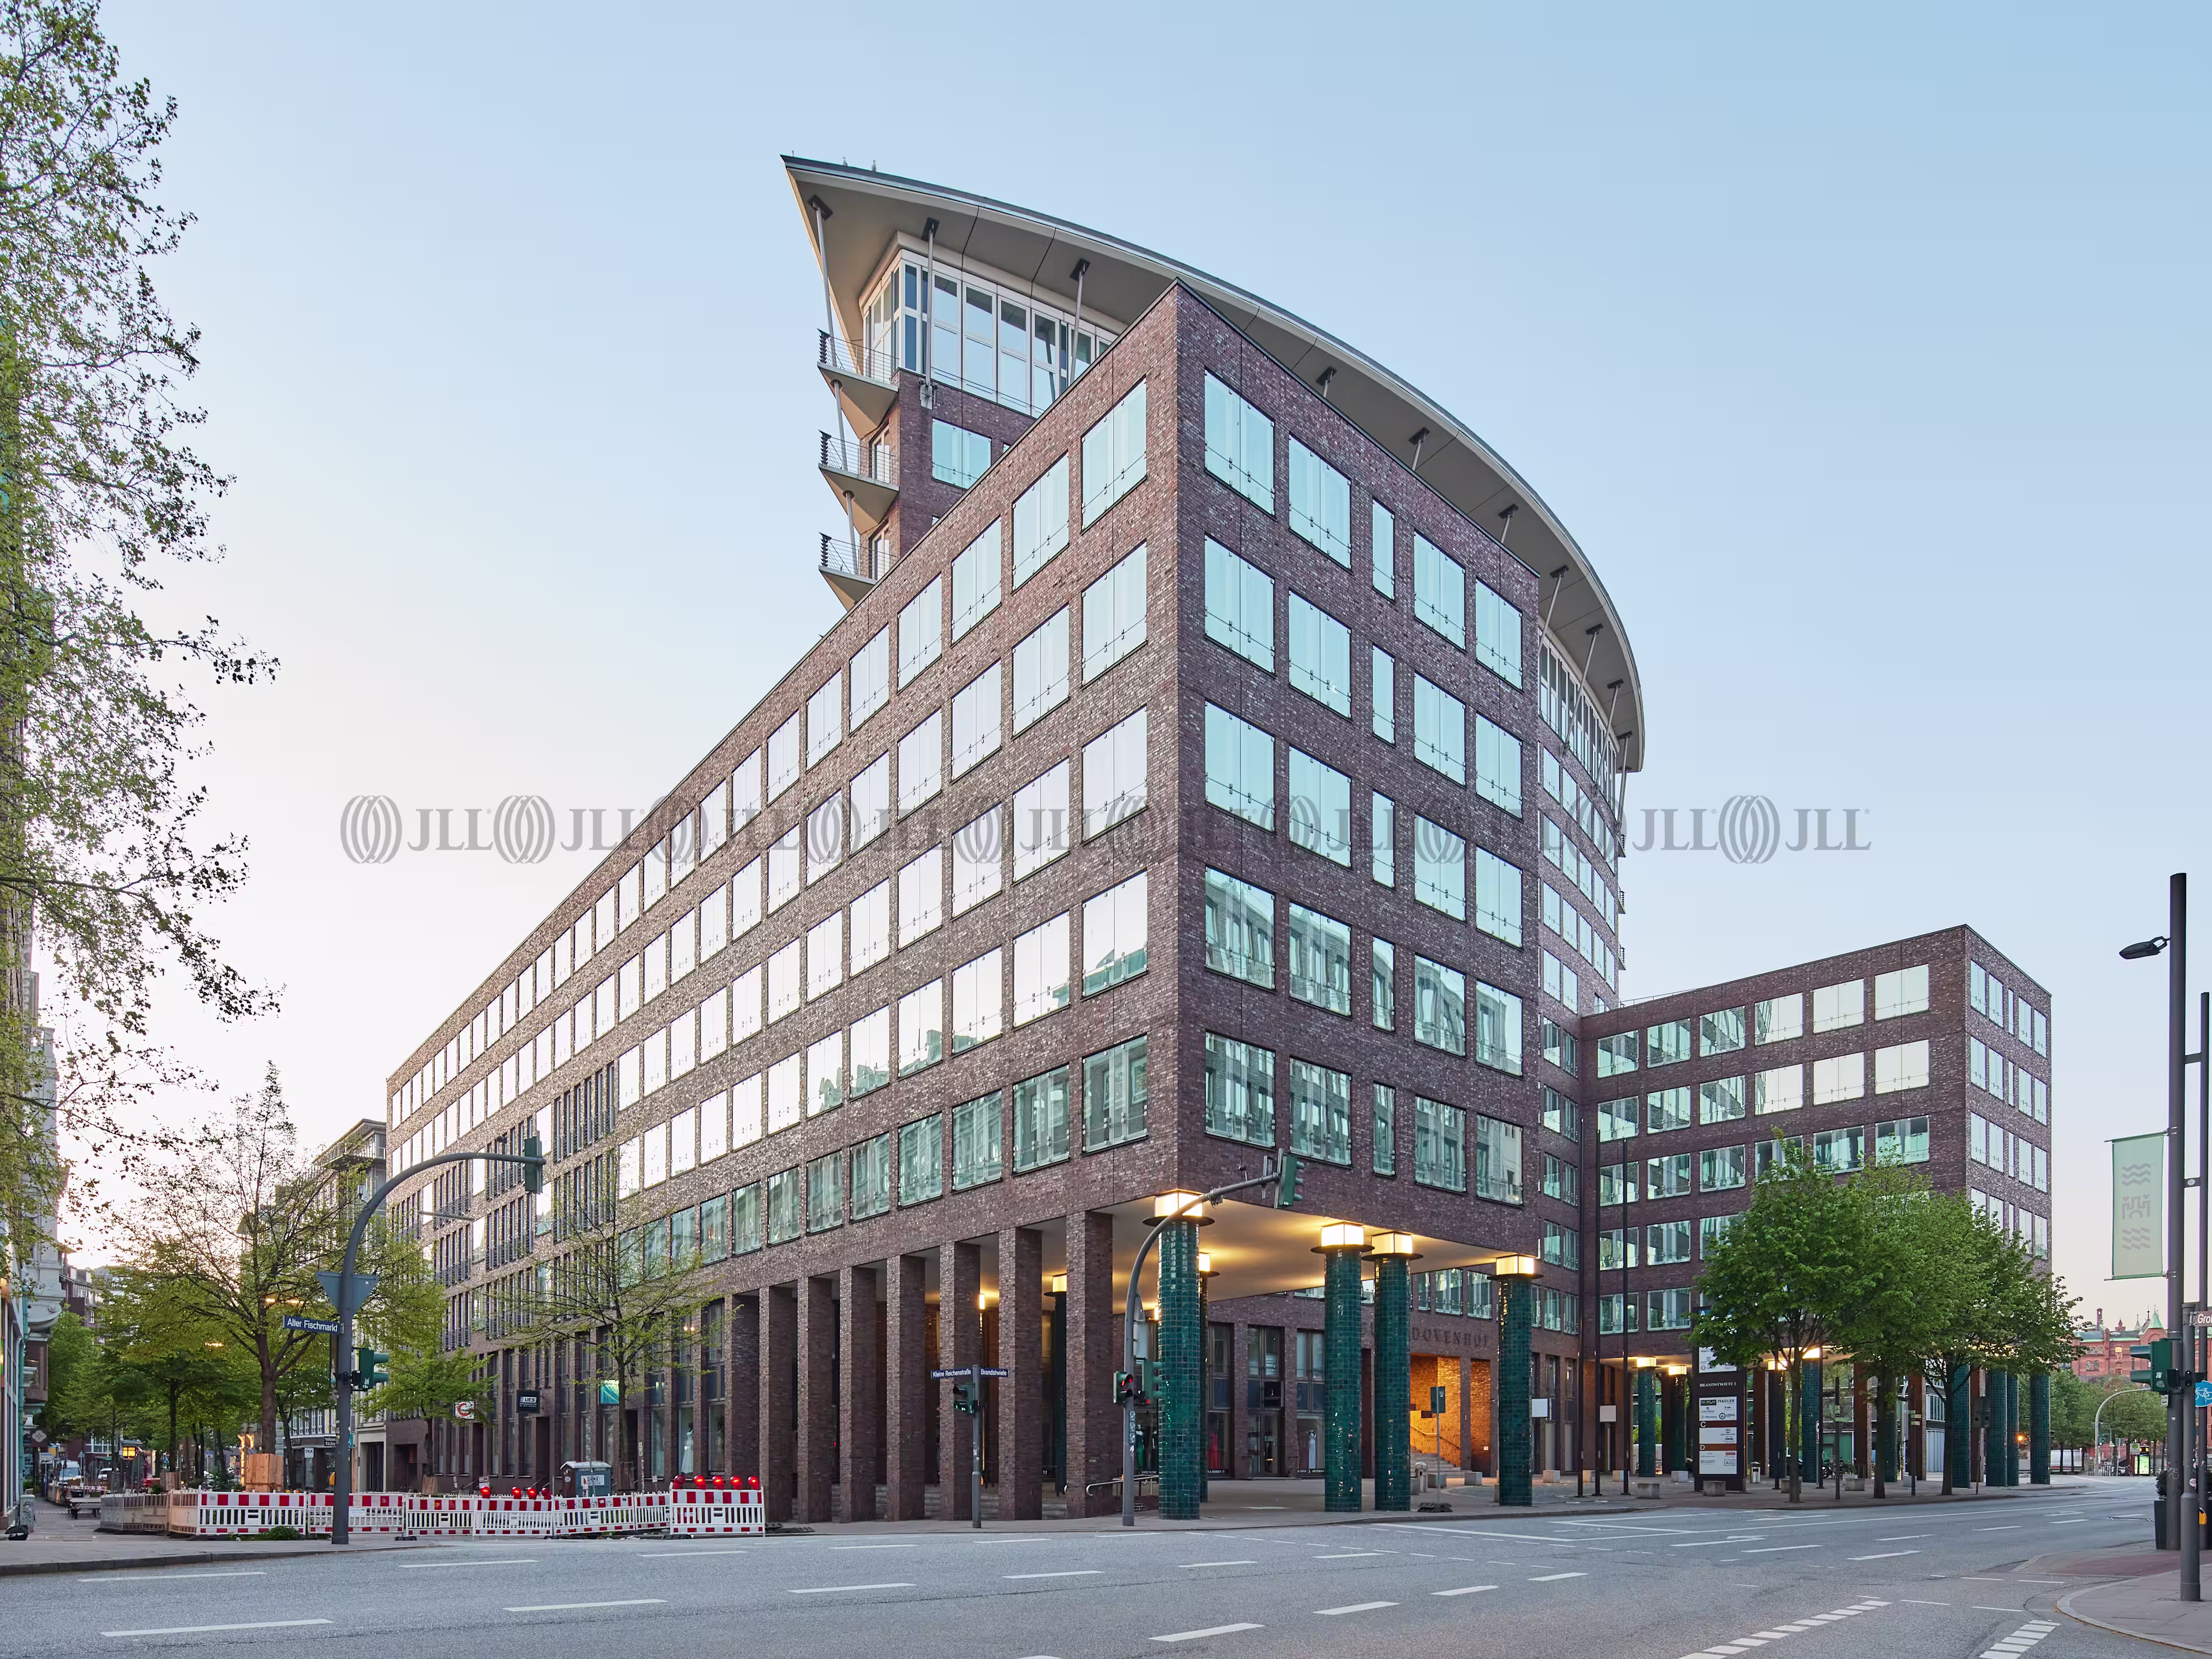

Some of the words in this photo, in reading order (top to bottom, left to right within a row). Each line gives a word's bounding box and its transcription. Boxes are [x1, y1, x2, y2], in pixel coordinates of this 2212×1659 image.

[2198, 1313, 2212, 1324] Gro
[287, 1318, 302, 1327] Alter
[304, 1320, 338, 1332] Fischmarkt
